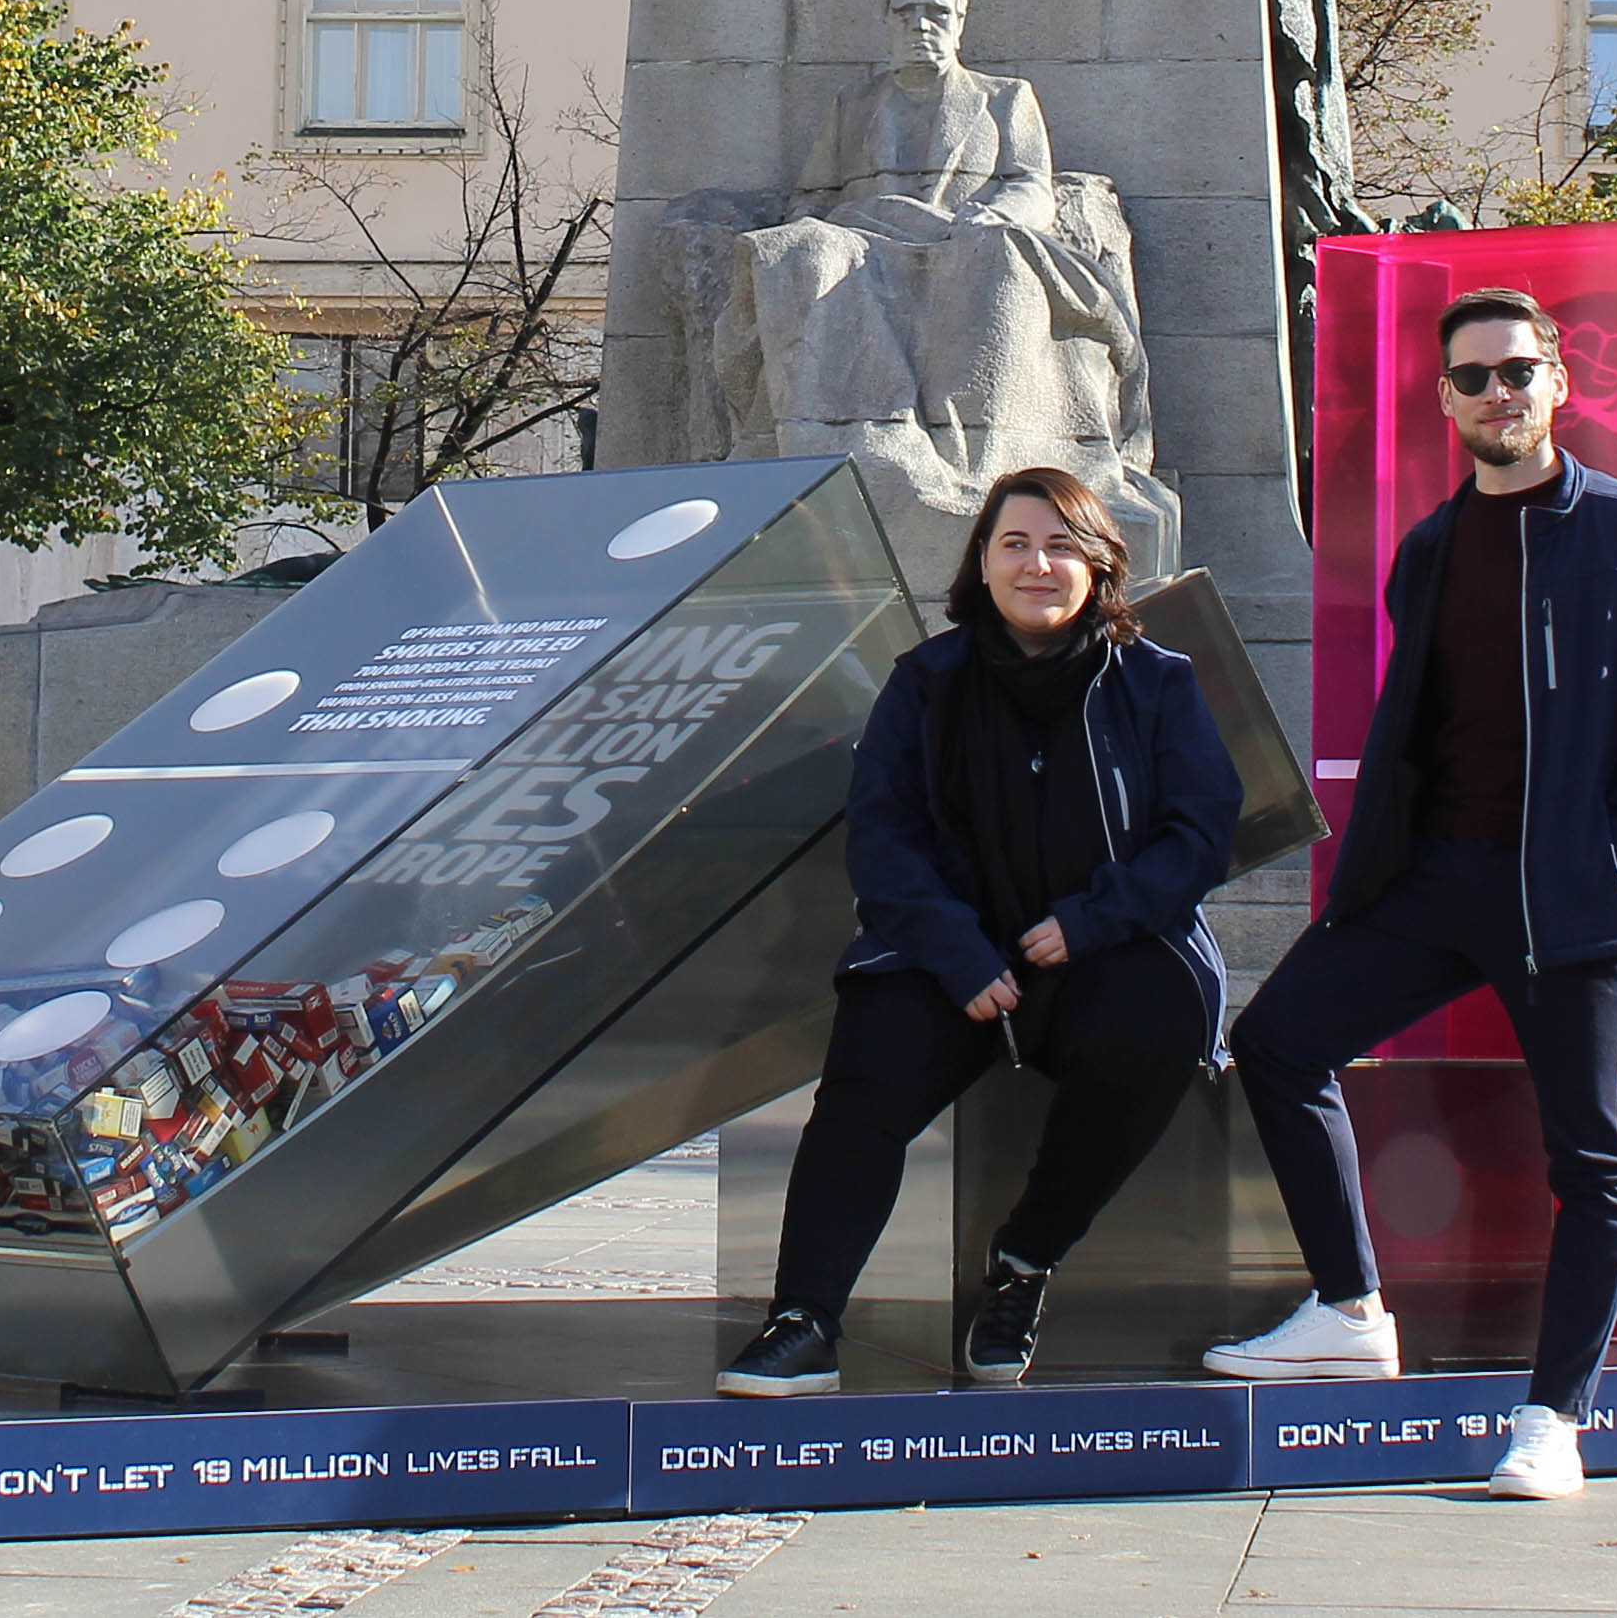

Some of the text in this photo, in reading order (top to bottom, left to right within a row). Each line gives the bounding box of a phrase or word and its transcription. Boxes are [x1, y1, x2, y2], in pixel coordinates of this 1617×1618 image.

[400, 628, 429, 640] OF
[422, 625, 473, 639] MORE
[469, 622, 519, 637] THAN
[534, 617, 608, 632] MILLION
[373, 635, 587, 661] SMOKERS IN THE EU
[353, 657, 561, 678] 700 000 PEOPLE DIE YEARLY
[316, 694, 372, 709] VAPING
[413, 691, 454, 704] LESS
[448, 689, 518, 703] HARMFUL
[582, 682, 743, 720] SAVE
[288, 706, 493, 732] THAN SMOKING.
[1277, 1418, 1372, 1447] DON'T
[1380, 1419, 1441, 1442] LET
[1455, 1415, 1487, 1436] 19
[660, 1428, 1220, 1470] DON'T LET 19 MILLION LIVES FALL
[98, 1463, 174, 1491] LET
[192, 1460, 231, 1484] 19
[242, 1452, 389, 1482] MILLION
[406, 1449, 500, 1473] LIVES
[509, 1445, 596, 1469] FALL
